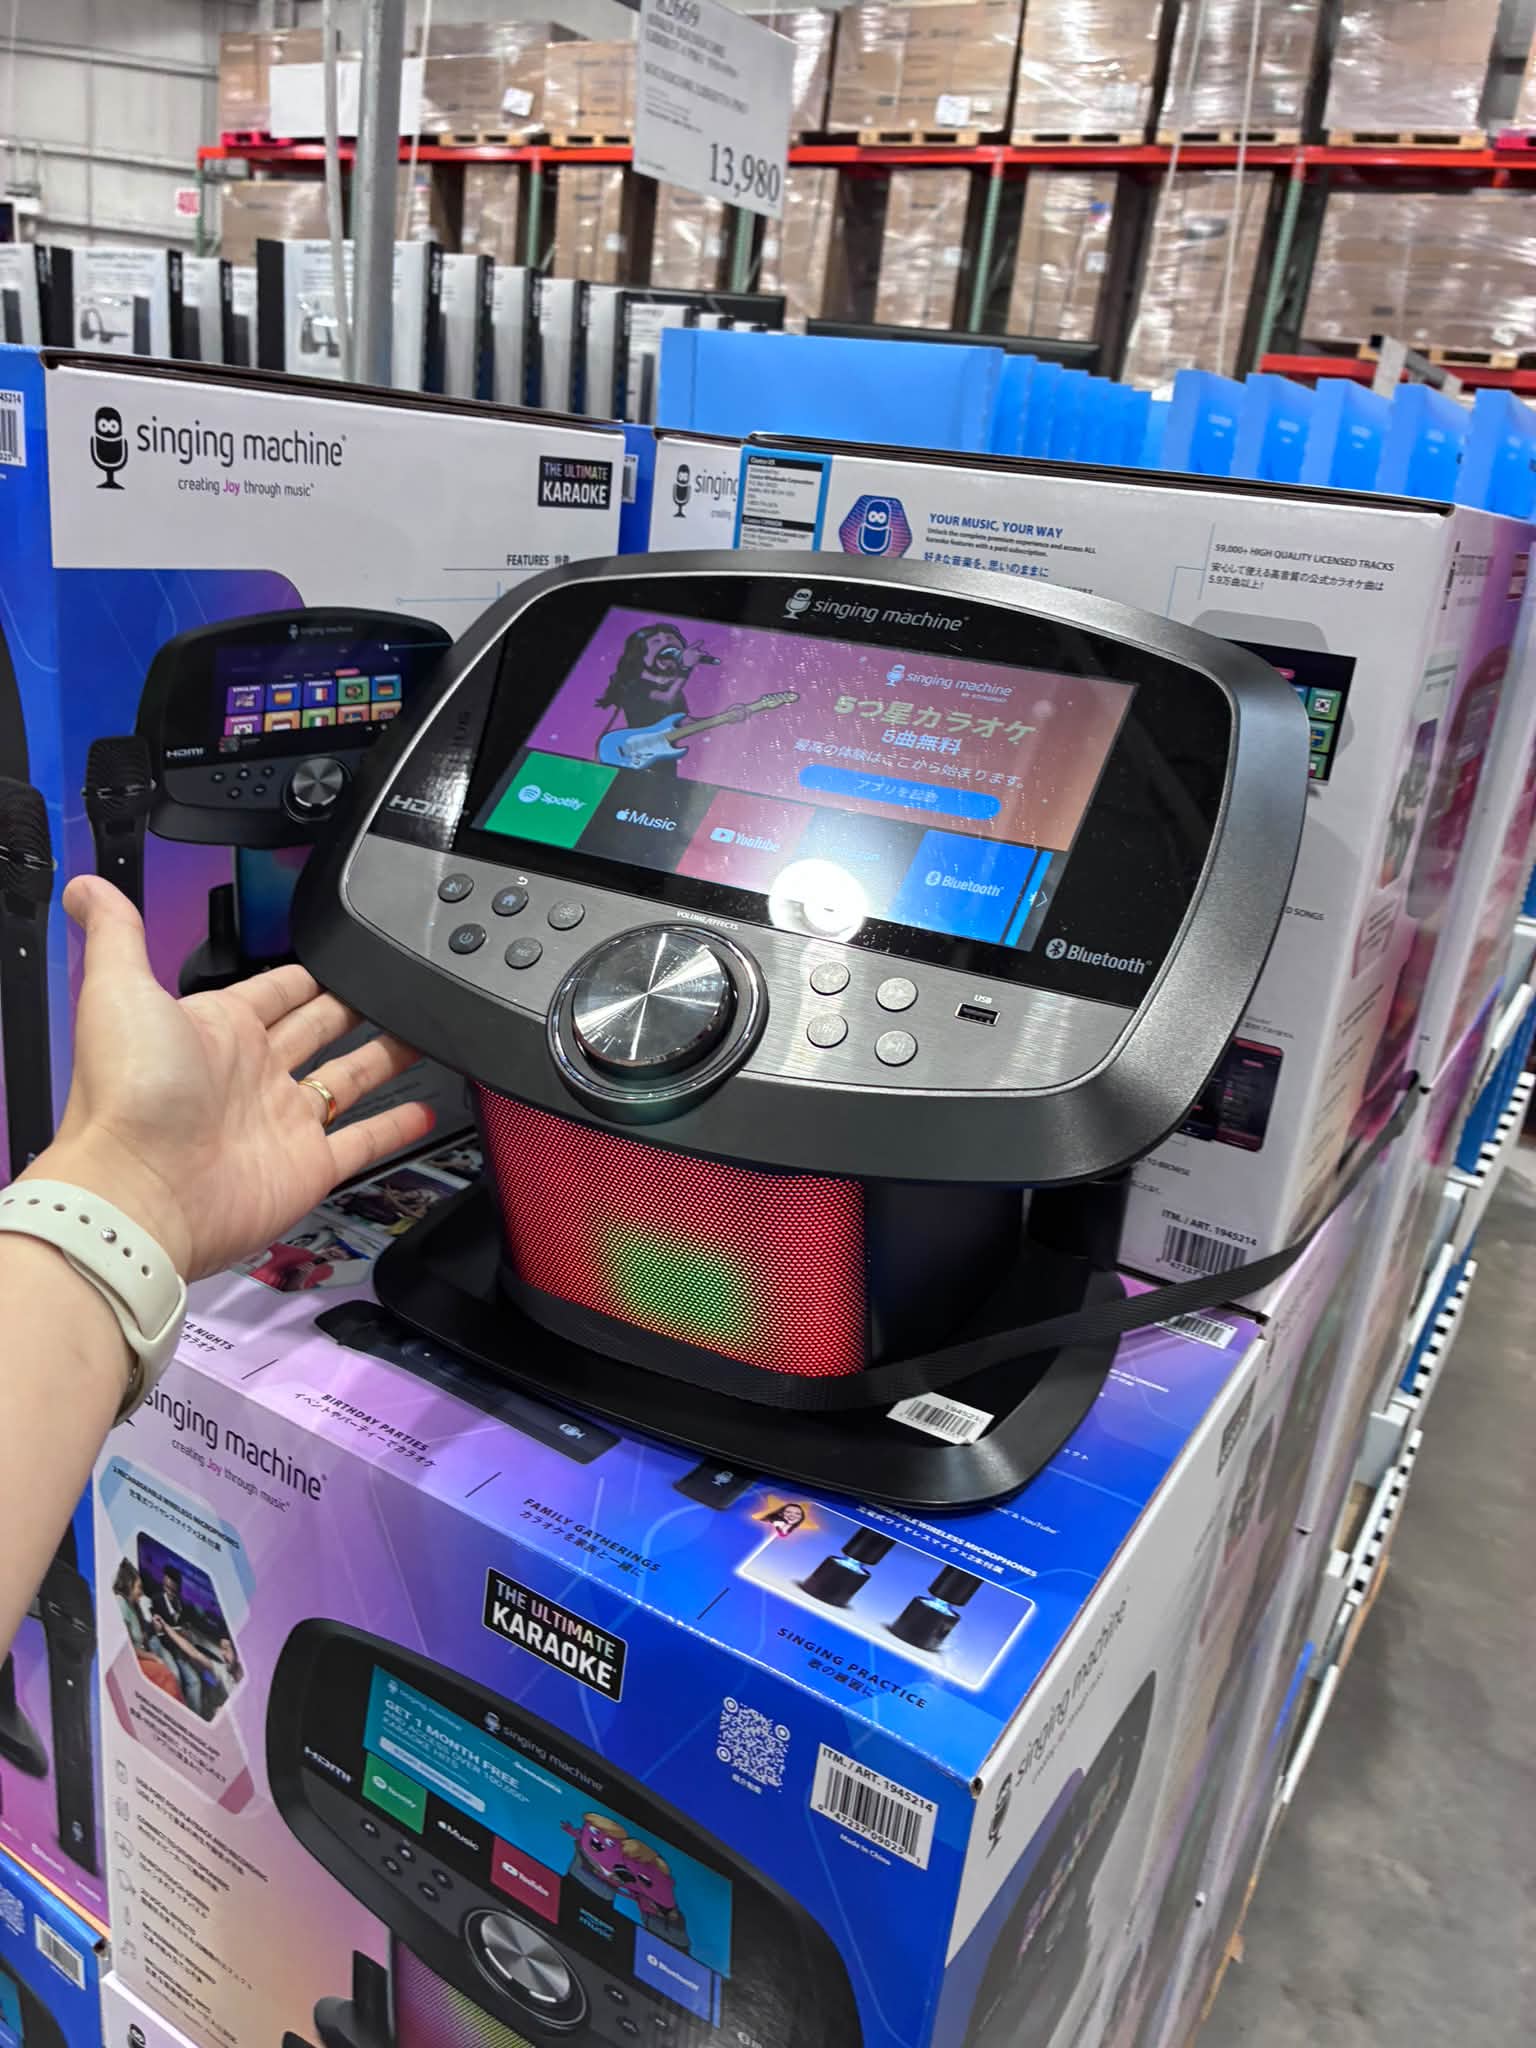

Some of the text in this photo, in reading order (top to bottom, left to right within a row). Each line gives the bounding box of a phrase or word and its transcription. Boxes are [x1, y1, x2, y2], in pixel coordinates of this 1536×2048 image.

[710, 142, 781, 202] 13,980
[137, 415, 343, 468] singing machine
[544, 462, 609, 481] THE ULTIMATE
[178, 477, 312, 498] creating Joy through music
[543, 481, 608, 504] KARAOKE
[929, 513, 1063, 538] YOUR MUSIC, YOUR WAY
[950, 538, 974, 548] features
[975, 541, 989, 550] with
[960, 531, 987, 541] complete
[987, 534, 1015, 544] premium
[1051, 542, 1063, 550] and
[506, 554, 549, 566] FEATURES
[1215, 543, 1395, 571] 59,000+ HIGH QUALITY LICENSED TRACKS
[814, 598, 962, 632] singing machine
[907, 671, 1014, 697] singing machine
[834, 695, 1036, 744] 5つ星カラオケ
[881, 729, 963, 756] 5曲無料
[389, 794, 450, 820] HDM
[541, 791, 584, 812] Spotify
[627, 809, 677, 832] Music
[735, 831, 781, 854] YouTube
[941, 874, 1001, 897] Bluetooth
[1066, 944, 1147, 975] Bluetooth
[974, 994, 993, 1004] USB
[1215, 1227, 1257, 1246] 1945214
[195, 1326, 235, 1351] NIGHTS
[321, 1394, 430, 1451] BIRTHDAY PARTIES
[171, 1438, 205, 1468] creating
[206, 1457, 222, 1477] Joy
[224, 1464, 259, 1496] through
[225, 1429, 322, 1501] machine
[523, 1498, 661, 1572] FAMILY GATHERINGS
[914, 1518, 964, 1546] WIRELESS
[964, 1540, 1038, 1577] MICROPHONES
[495, 1578, 616, 1660] THE ULTIMATE
[492, 1601, 612, 1690] KARAOKE
[776, 1627, 928, 1709] SINGING PRACTICE
[384, 1699, 411, 1720] GET
[425, 1721, 480, 1764] MONTH
[481, 1757, 520, 1789] FREE
[822, 1748, 848, 1768] ITM.
[855, 1765, 882, 1787] ART.
[883, 1781, 934, 1813] 1945214
